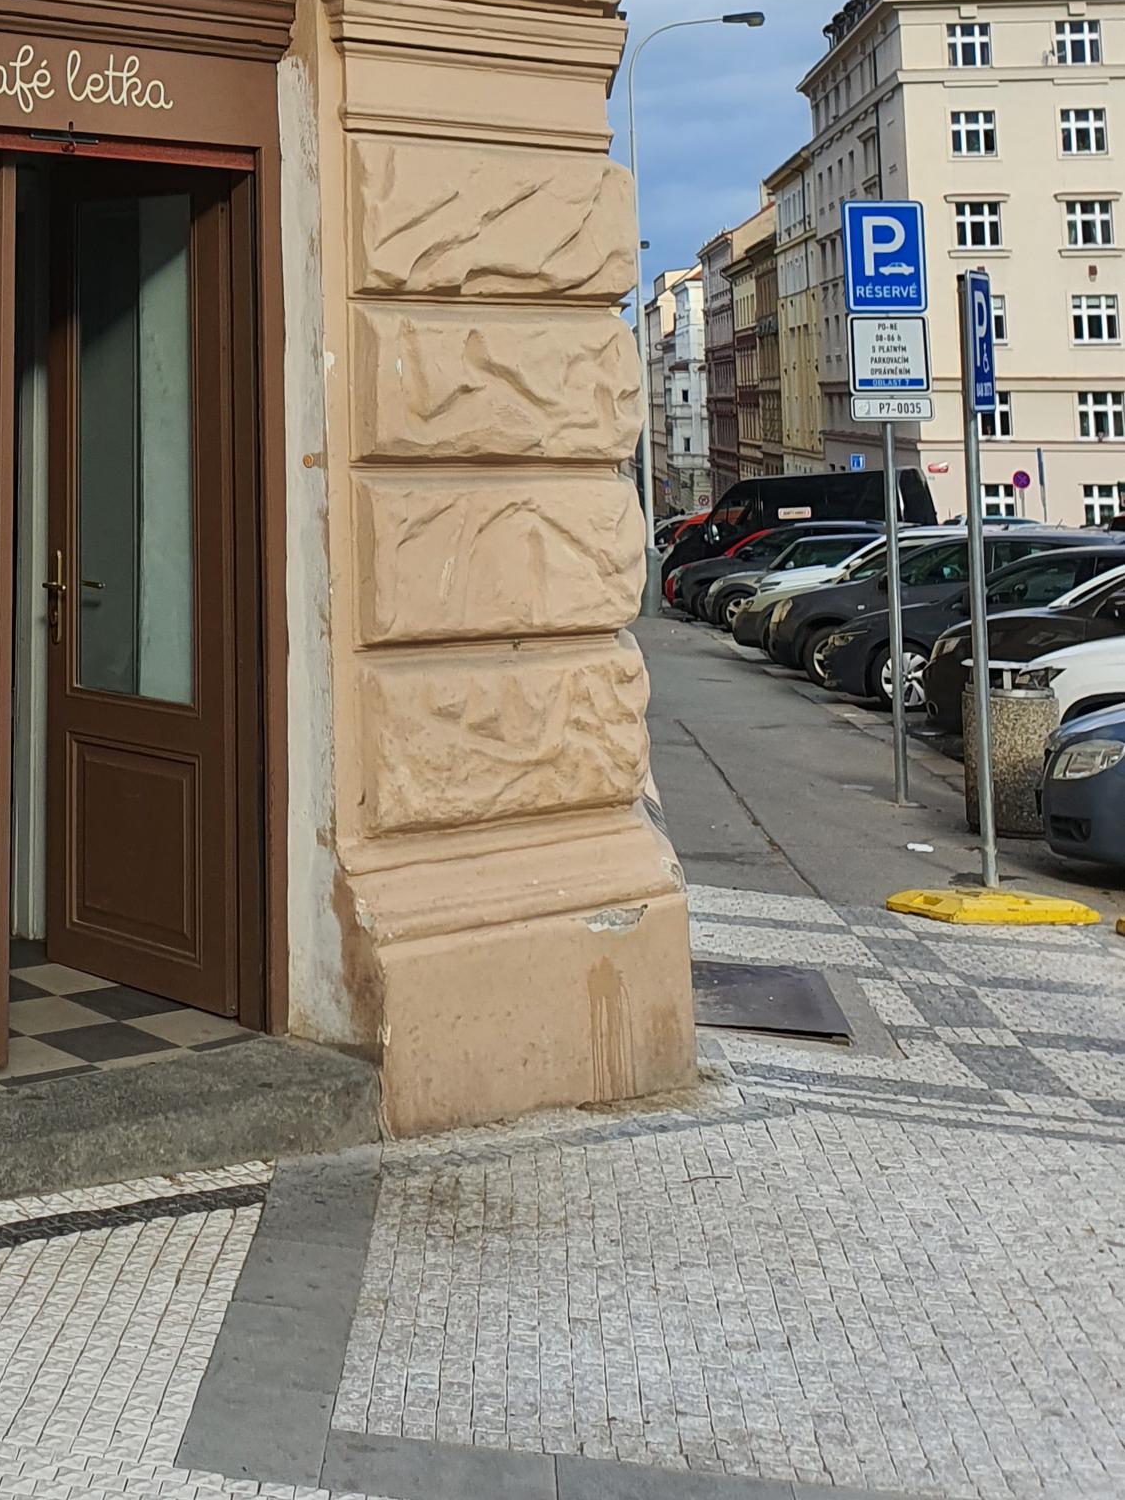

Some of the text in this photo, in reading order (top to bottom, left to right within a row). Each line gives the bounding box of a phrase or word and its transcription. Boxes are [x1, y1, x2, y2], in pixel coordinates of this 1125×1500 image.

[66, 48, 174, 110] letka
[862, 215, 906, 276] P
[856, 282, 918, 299] RÉSERVÉ
[974, 291, 987, 367] P
[878, 344, 907, 353] PLATNÝM
[870, 355, 909, 365] PARKOVACÍM
[879, 402, 922, 414] P7-0035
